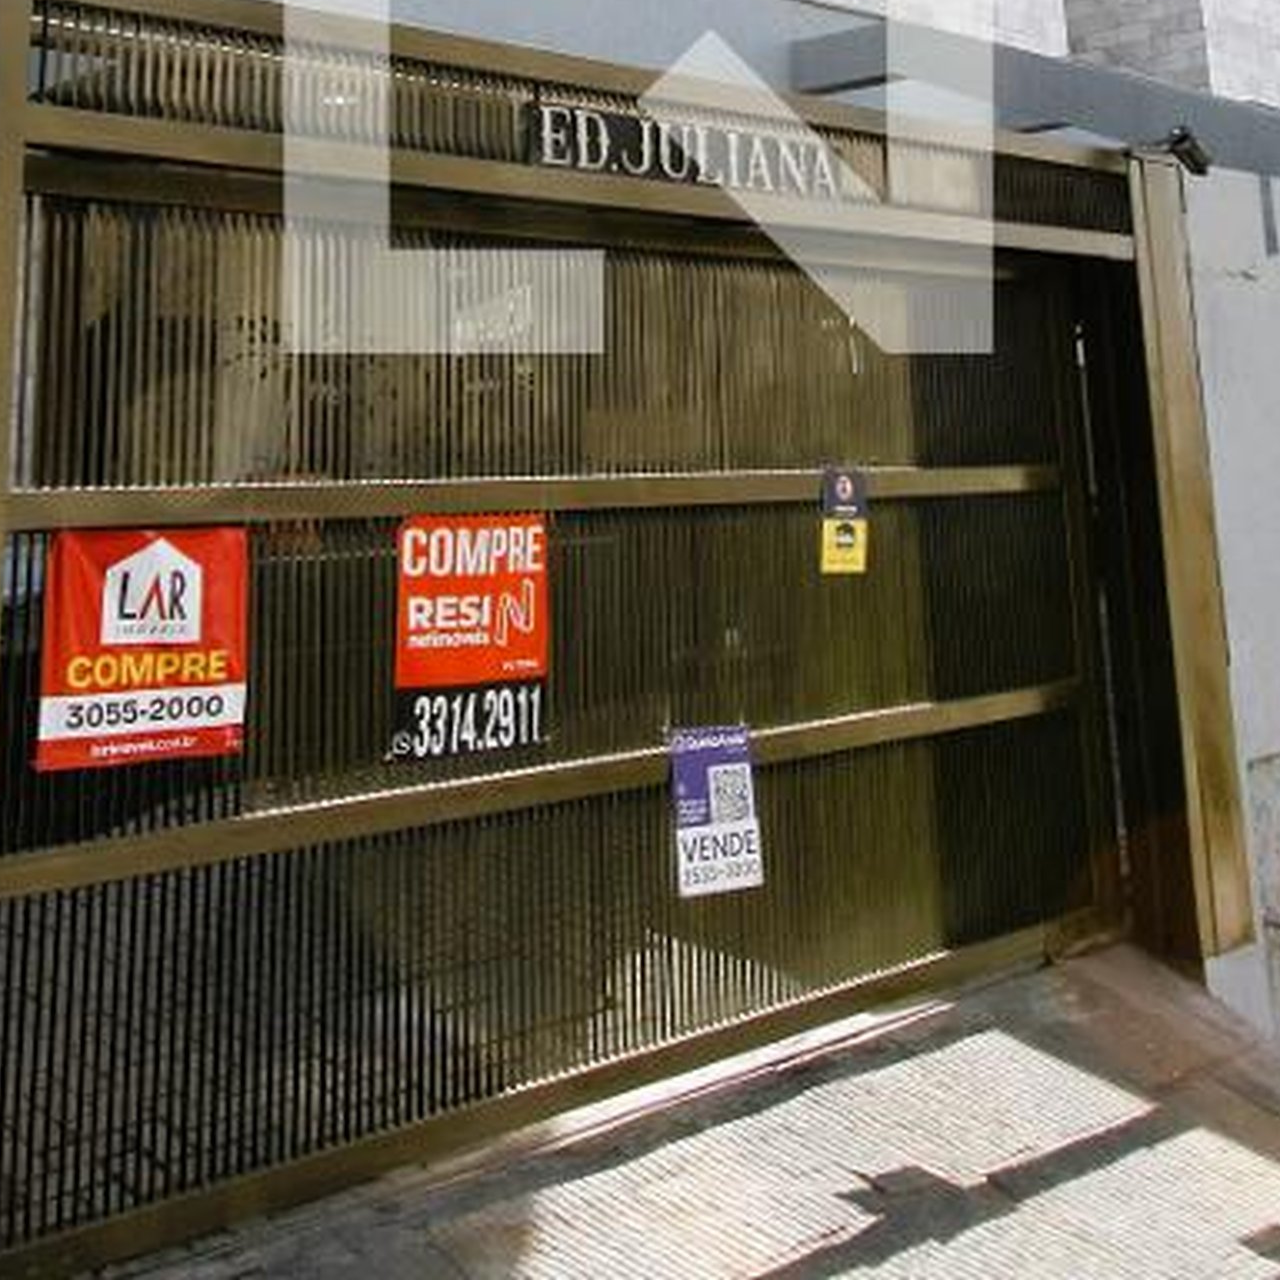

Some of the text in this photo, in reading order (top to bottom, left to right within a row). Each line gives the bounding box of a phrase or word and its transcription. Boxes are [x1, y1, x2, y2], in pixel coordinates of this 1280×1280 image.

[402, 525, 545, 577] COMPRE
[117, 571, 187, 620] LAR
[408, 595, 491, 629] RESI
[66, 650, 229, 689] COMPRE
[65, 695, 225, 729] 3055-2000
[682, 829, 757, 863] VENDE
